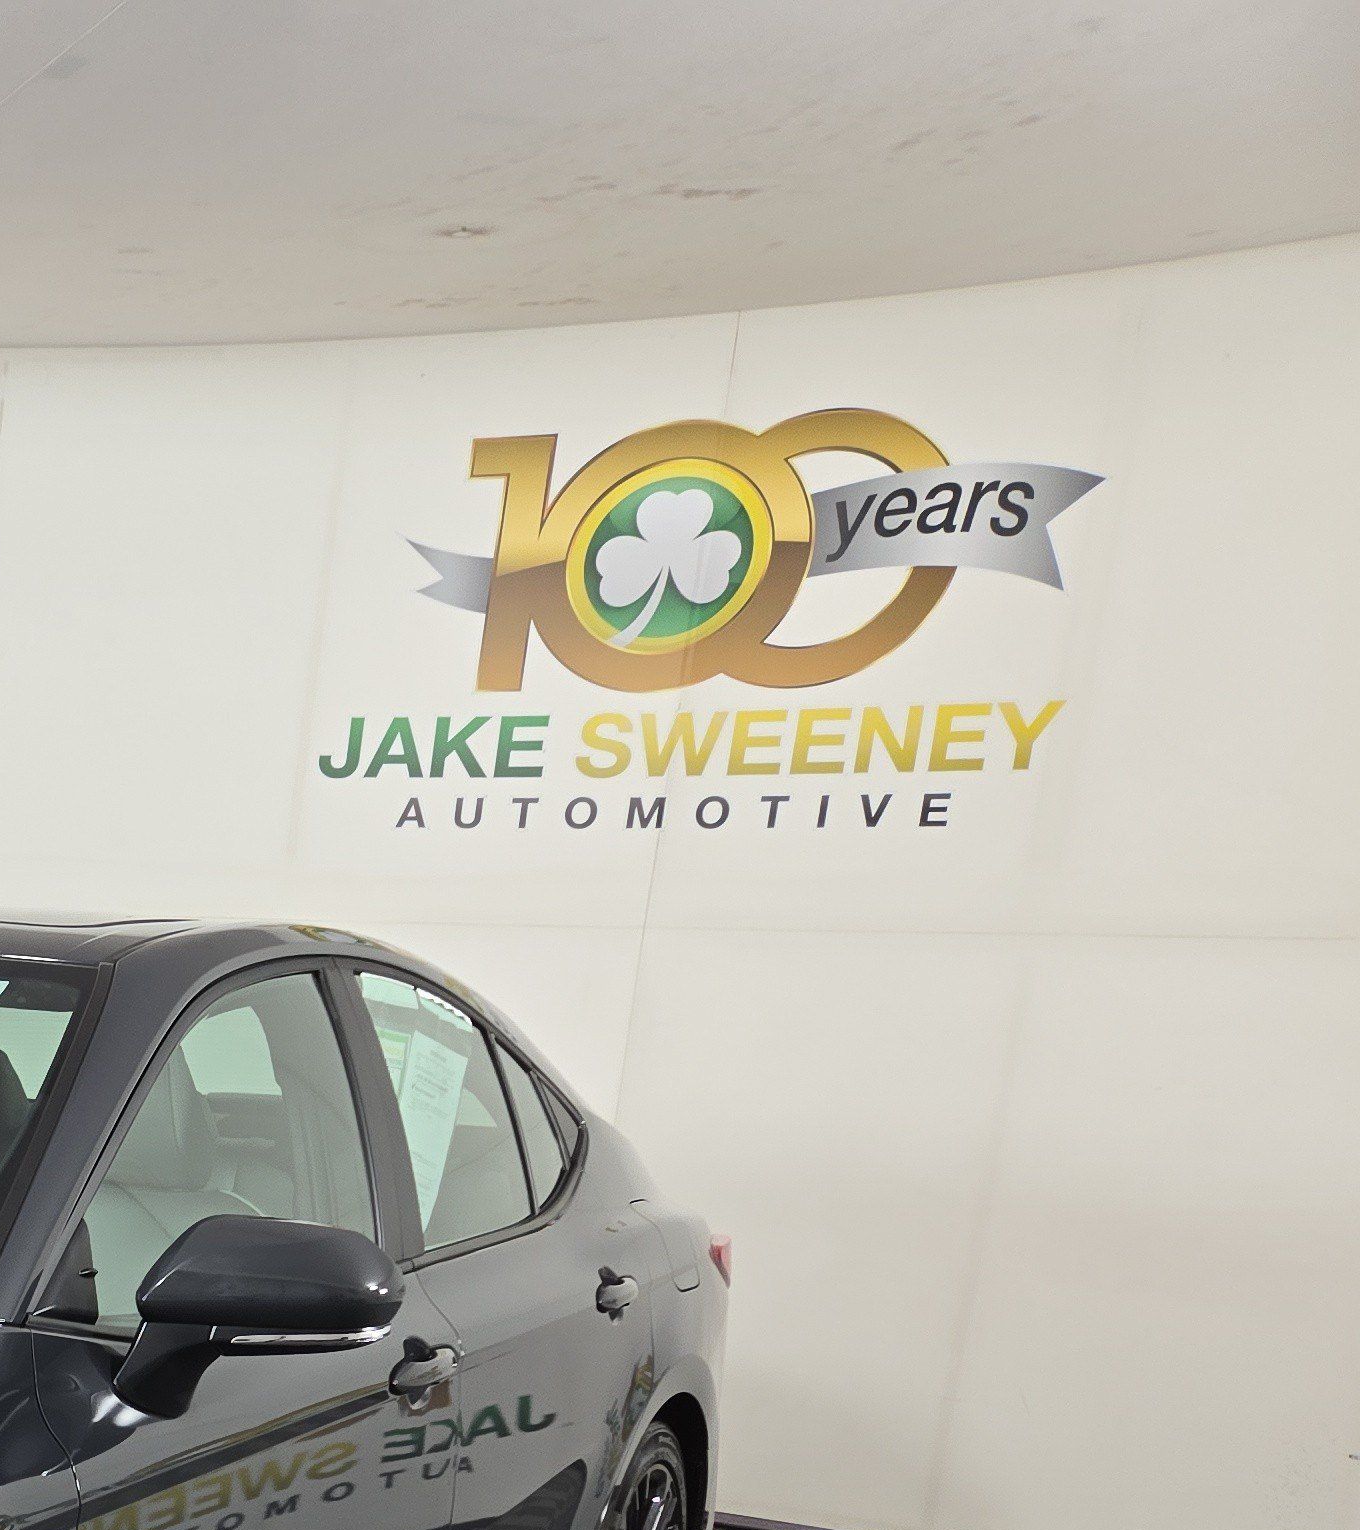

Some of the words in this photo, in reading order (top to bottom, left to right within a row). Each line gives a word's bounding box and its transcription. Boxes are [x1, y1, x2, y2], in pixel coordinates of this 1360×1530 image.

[470, 407, 957, 693] 100
[826, 471, 1035, 563] years
[318, 715, 550, 779] JAKE
[576, 699, 1066, 778] SWEENEY
[396, 793, 952, 829] AUTOMOTIVE
